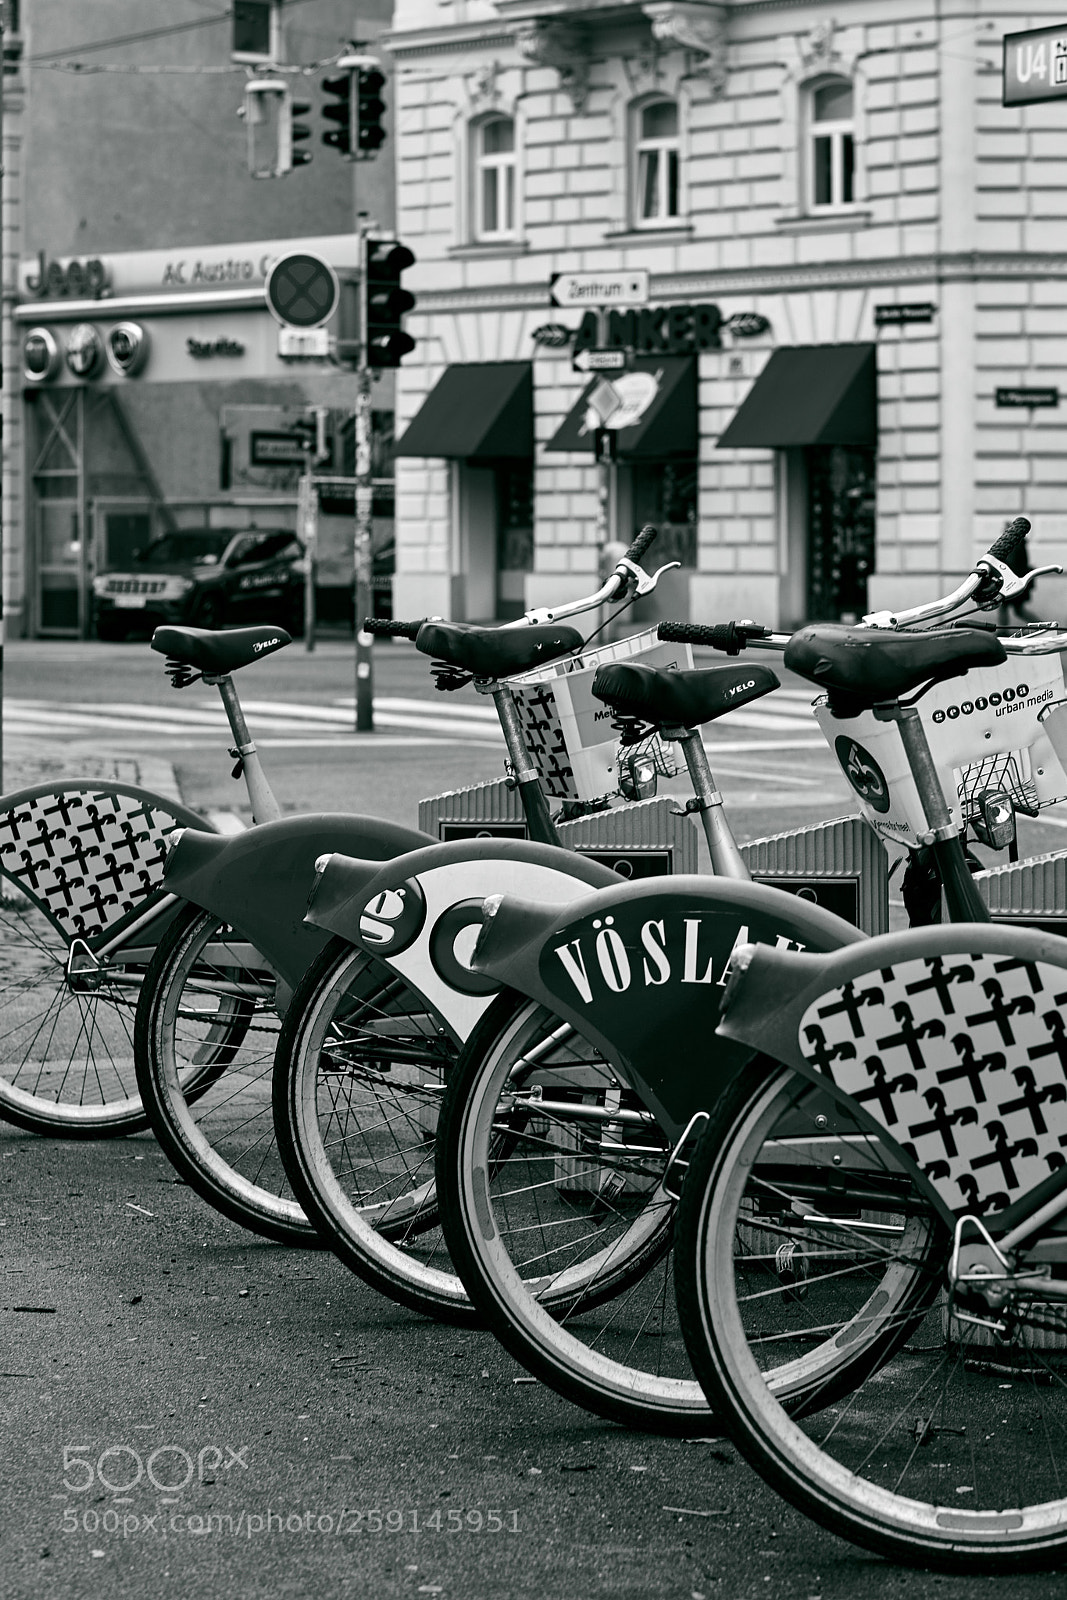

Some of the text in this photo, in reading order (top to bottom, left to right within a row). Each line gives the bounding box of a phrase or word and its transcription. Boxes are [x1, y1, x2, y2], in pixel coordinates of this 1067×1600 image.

[1016, 43, 1047, 83] U4
[573, 304, 723, 352] ANKER
[257, 637, 279, 651] VELO
[729, 680, 756, 696] VELO
[933, 684, 1029, 723] gewista
[995, 689, 1054, 717] urban media
[554, 915, 807, 1004] VÖSLA
